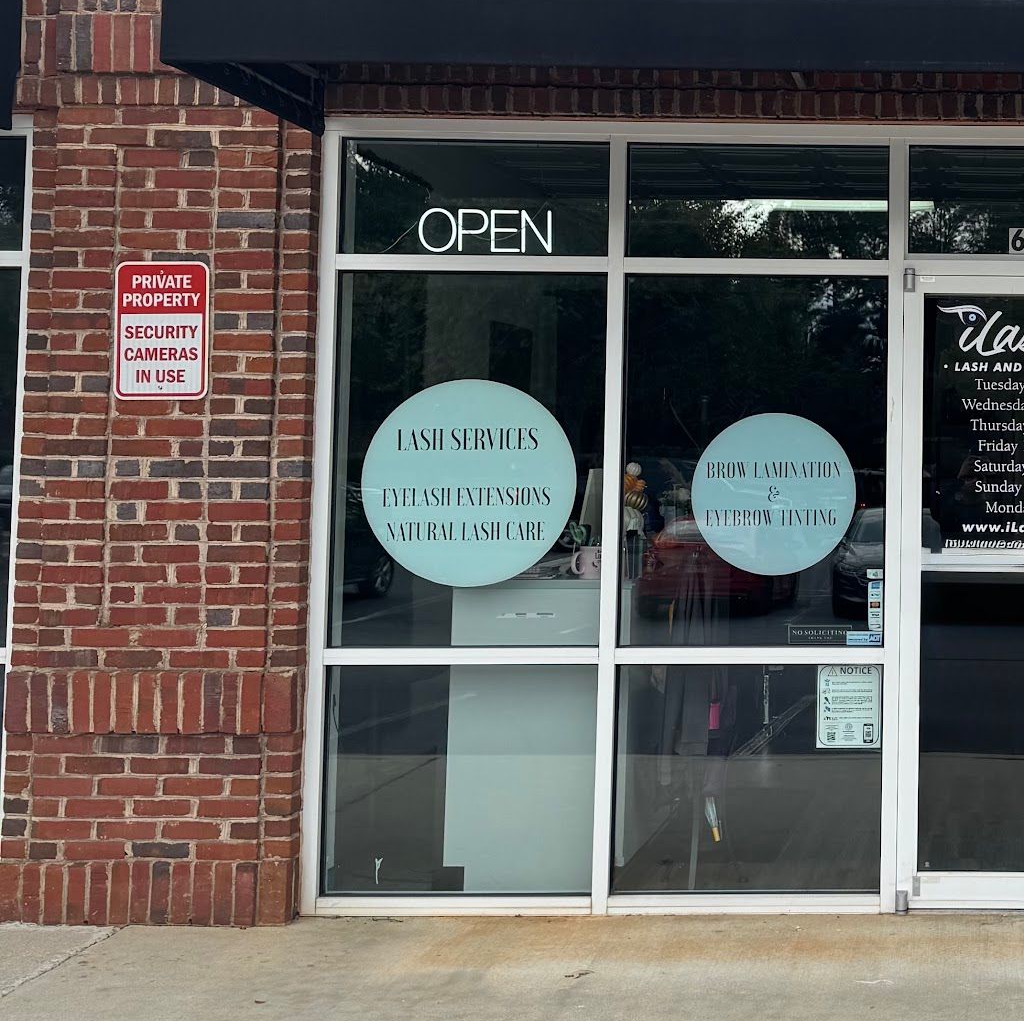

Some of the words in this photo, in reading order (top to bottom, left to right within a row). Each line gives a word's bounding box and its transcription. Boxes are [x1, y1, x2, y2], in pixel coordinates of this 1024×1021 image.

[418, 207, 553, 254] OPEN
[132, 274, 193, 289] PRIVATE
[122, 292, 201, 308] PROPERTY
[124, 325, 199, 340] SECURITY
[123, 347, 199, 362] CAMERAS
[954, 361, 989, 372] LASH
[992, 362, 1023, 373] AND
[135, 369, 150, 384] IN
[155, 369, 186, 383] USE
[397, 428, 445, 451] LASH
[450, 427, 539, 451] SERVICES
[978, 439, 1019, 456] Friday
[707, 461, 751, 479] BROW
[753, 461, 842, 479] LAMINATION
[382, 487, 452, 508] EYELASH
[457, 486, 551, 506] EXTENSIONS
[767, 485, 780, 502] &
[974, 480, 1024, 497] Sunday
[706, 509, 773, 527] EYEBROW
[781, 509, 837, 526] TINTING
[386, 521, 457, 542] NATURAL
[461, 521, 501, 541] LASH
[506, 521, 545, 541] CARE
[840, 666, 873, 675] NOTICE
